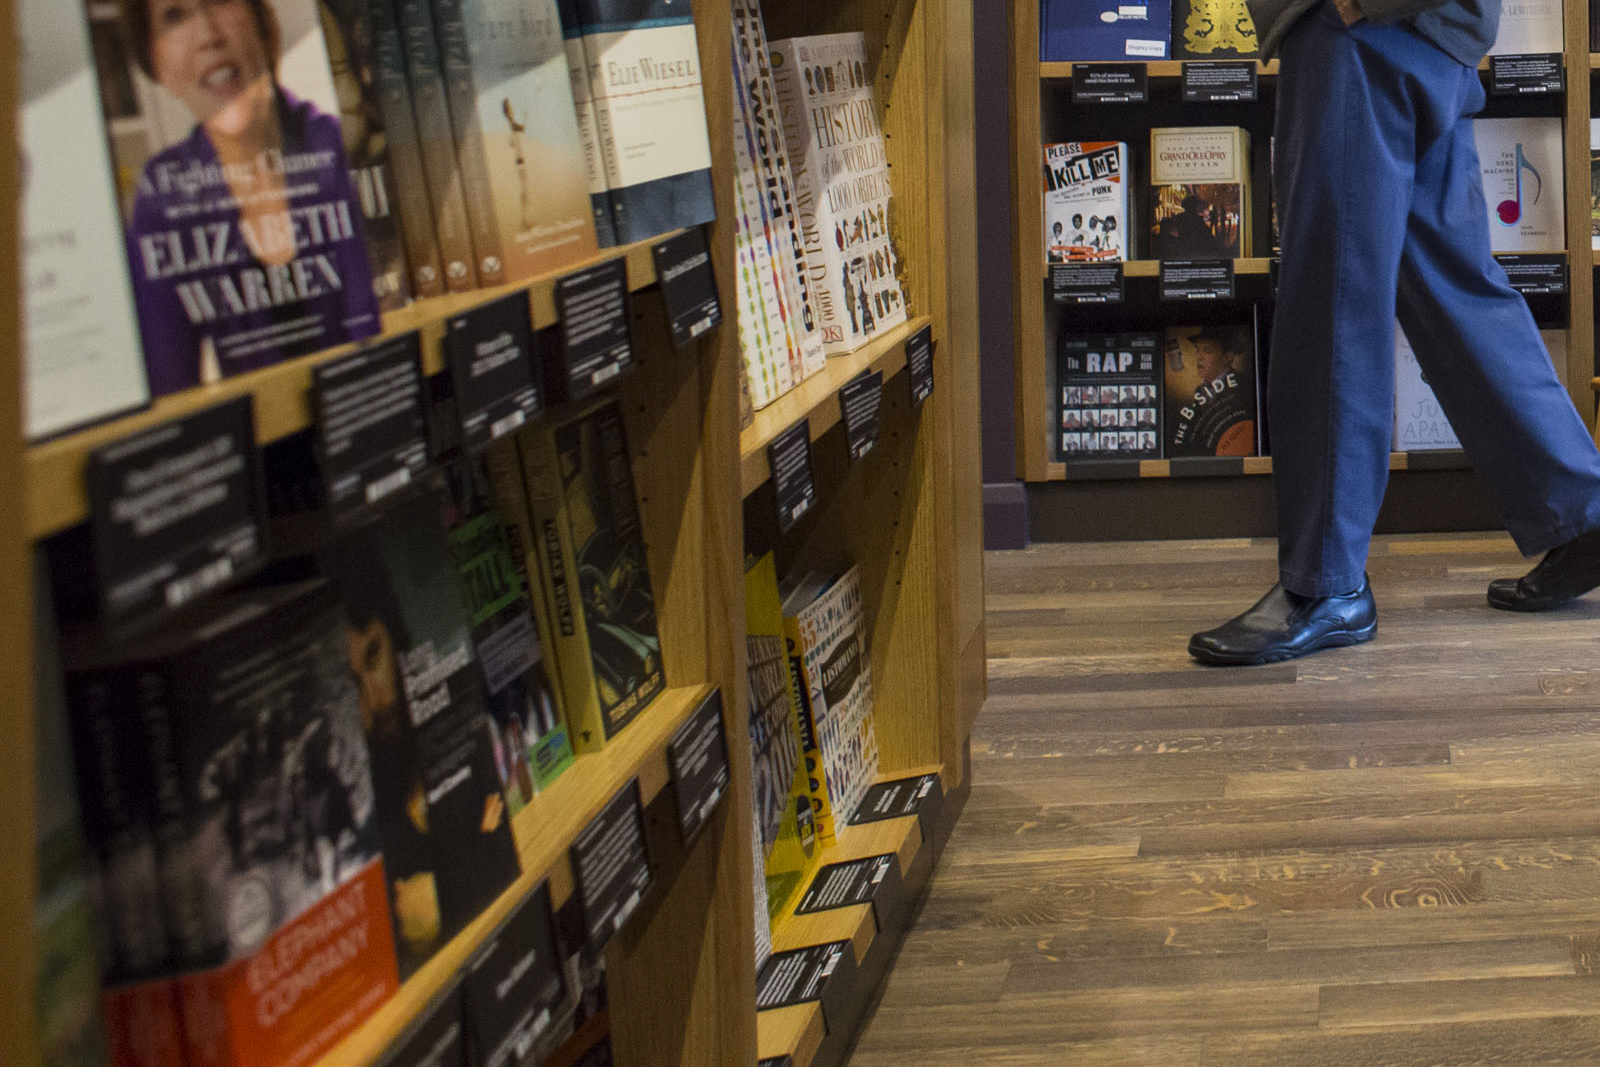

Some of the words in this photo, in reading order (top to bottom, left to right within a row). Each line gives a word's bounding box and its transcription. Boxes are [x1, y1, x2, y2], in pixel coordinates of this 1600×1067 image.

[608, 61, 641, 86] ELIE
[640, 52, 699, 81] WIESEL
[750, 76, 784, 220] World
[1048, 142, 1081, 159] PLEASE
[841, 146, 880, 177] WORLD
[1054, 157, 1091, 190] KILL
[1092, 150, 1119, 179] ME
[1091, 185, 1113, 197] PUNK
[176, 253, 343, 325] WARREN
[1068, 357, 1079, 369] The
[1087, 352, 1133, 373] RAP
[1175, 422, 1188, 444] THE
